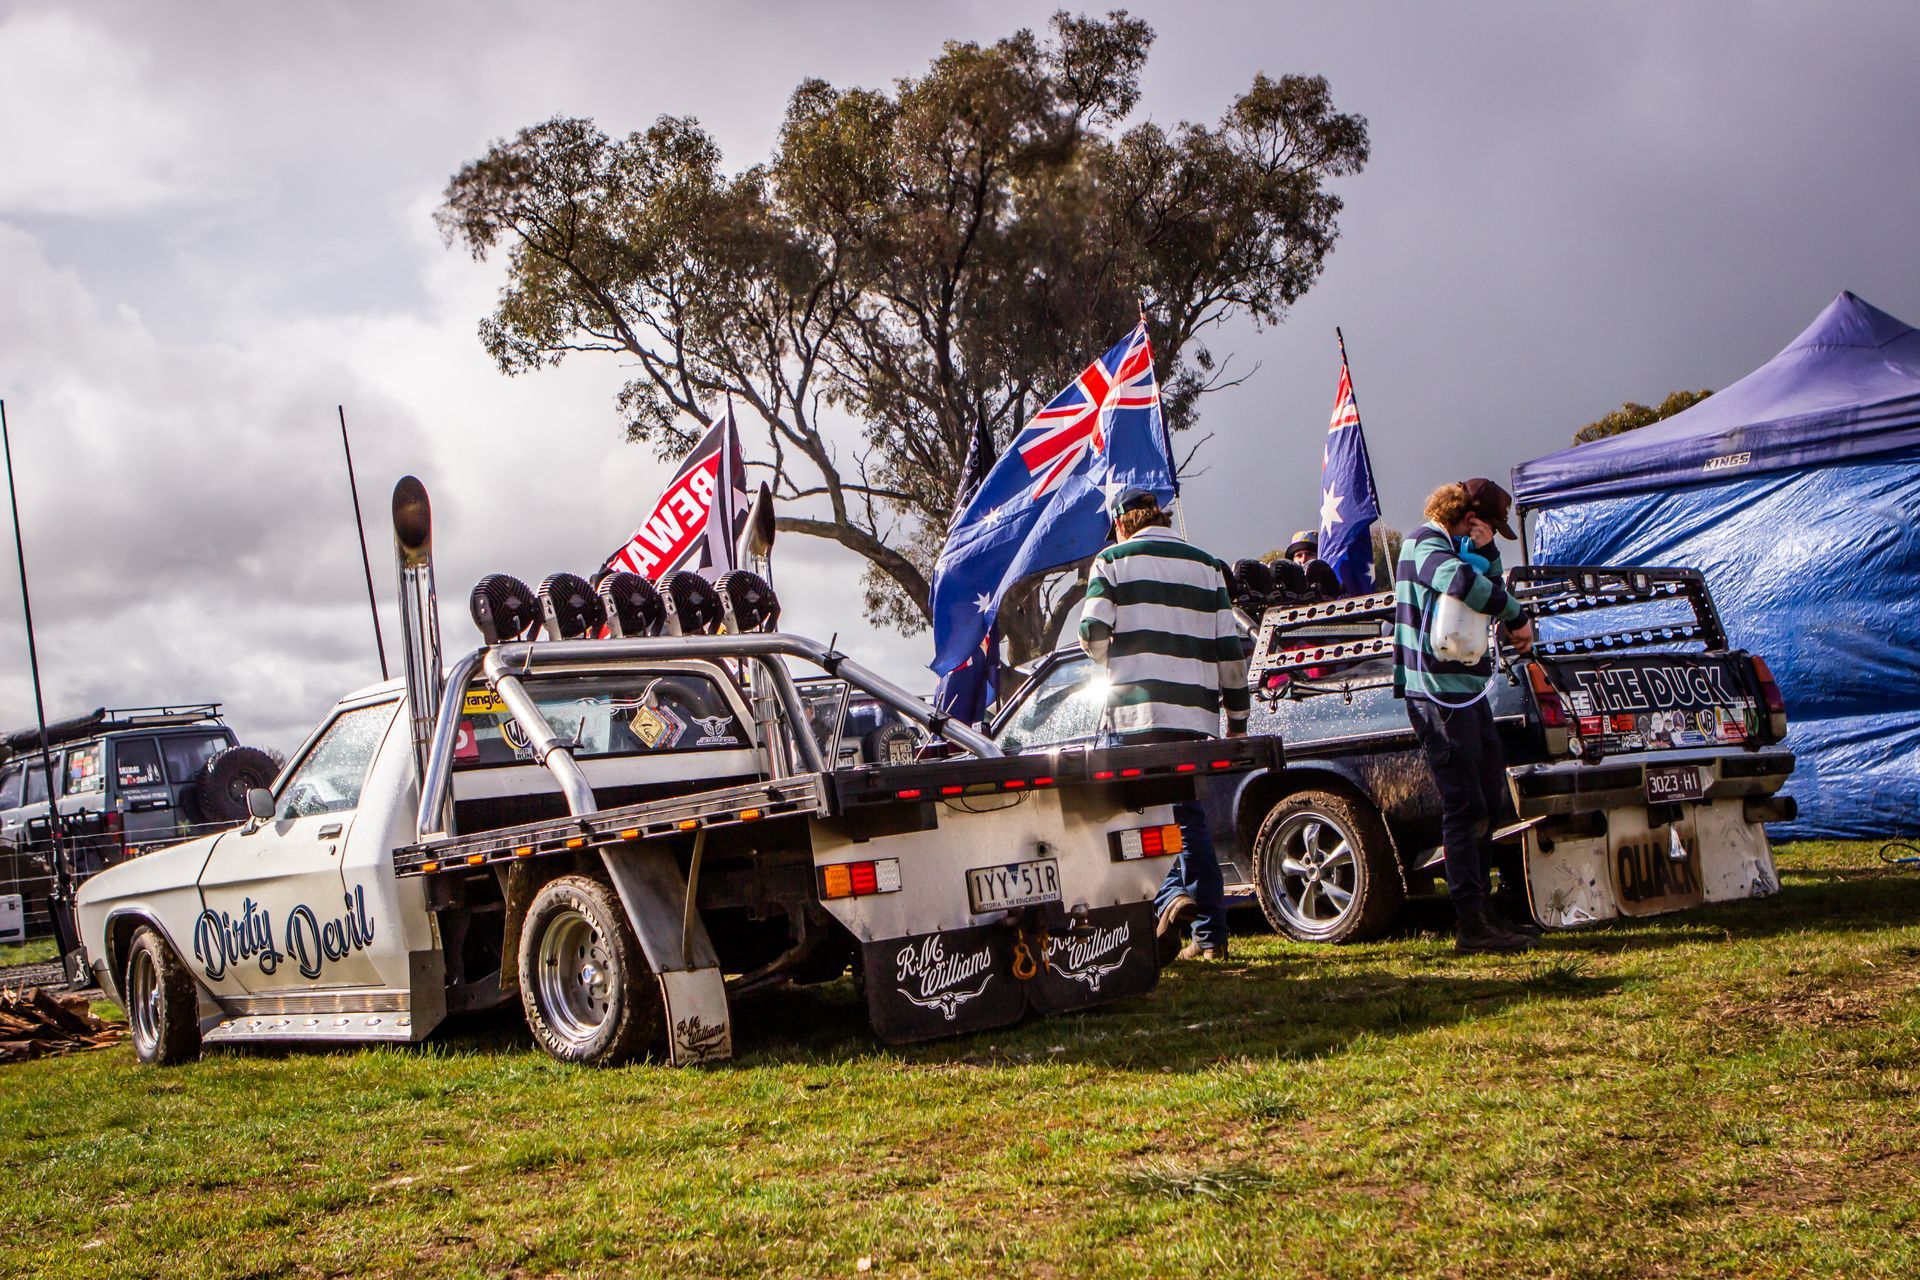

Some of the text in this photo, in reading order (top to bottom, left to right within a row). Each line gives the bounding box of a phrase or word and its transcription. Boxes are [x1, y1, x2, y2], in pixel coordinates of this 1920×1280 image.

[1704, 453, 1751, 470] KINGS
[466, 690, 504, 710] rangle
[1575, 668, 1649, 711] THE
[1643, 666, 1735, 707] DUCK
[517, 752, 533, 760] RUN
[975, 872, 1008, 902] 1YY
[1016, 896, 1042, 905] EDUCATION
[194, 884, 375, 981] Dirty Devil
[1067, 921, 1130, 970] Williams
[920, 946, 991, 997] Williams
[687, 1022, 725, 1046] Williams
